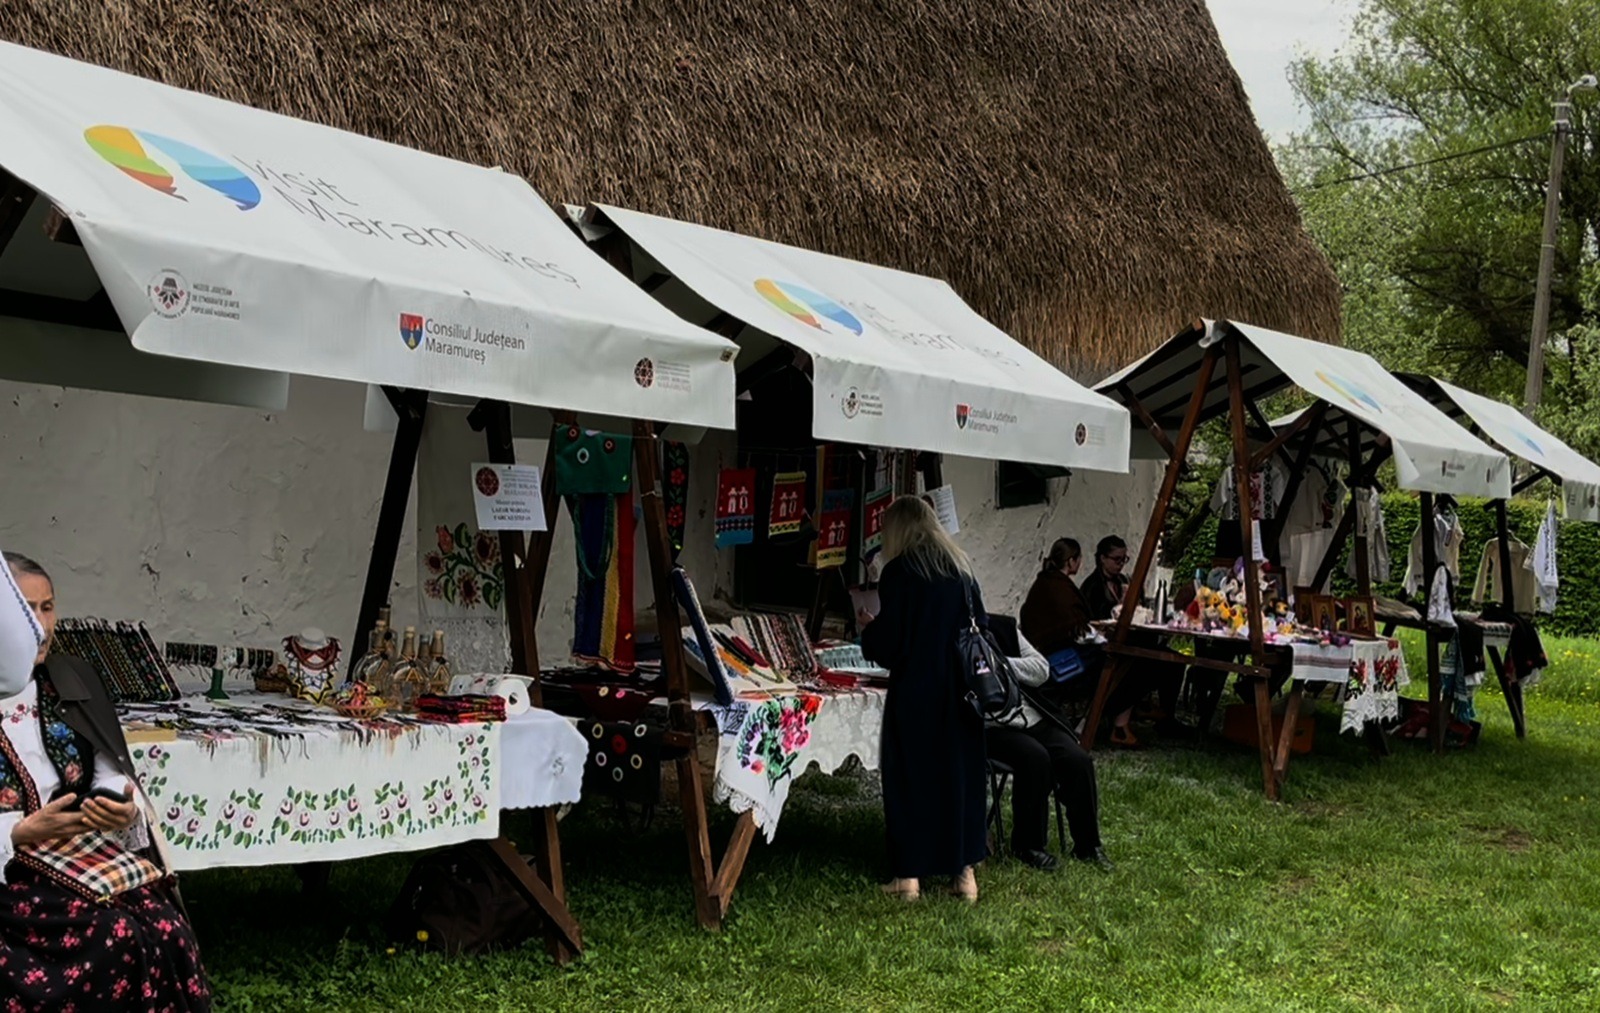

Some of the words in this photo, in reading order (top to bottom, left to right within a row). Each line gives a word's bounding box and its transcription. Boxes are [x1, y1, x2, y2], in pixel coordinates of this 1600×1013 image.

[233, 155, 359, 206] Visit
[425, 318, 472, 341] Consiliul
[473, 328, 525, 350] Județean
[425, 337, 486, 365] Maramureș
